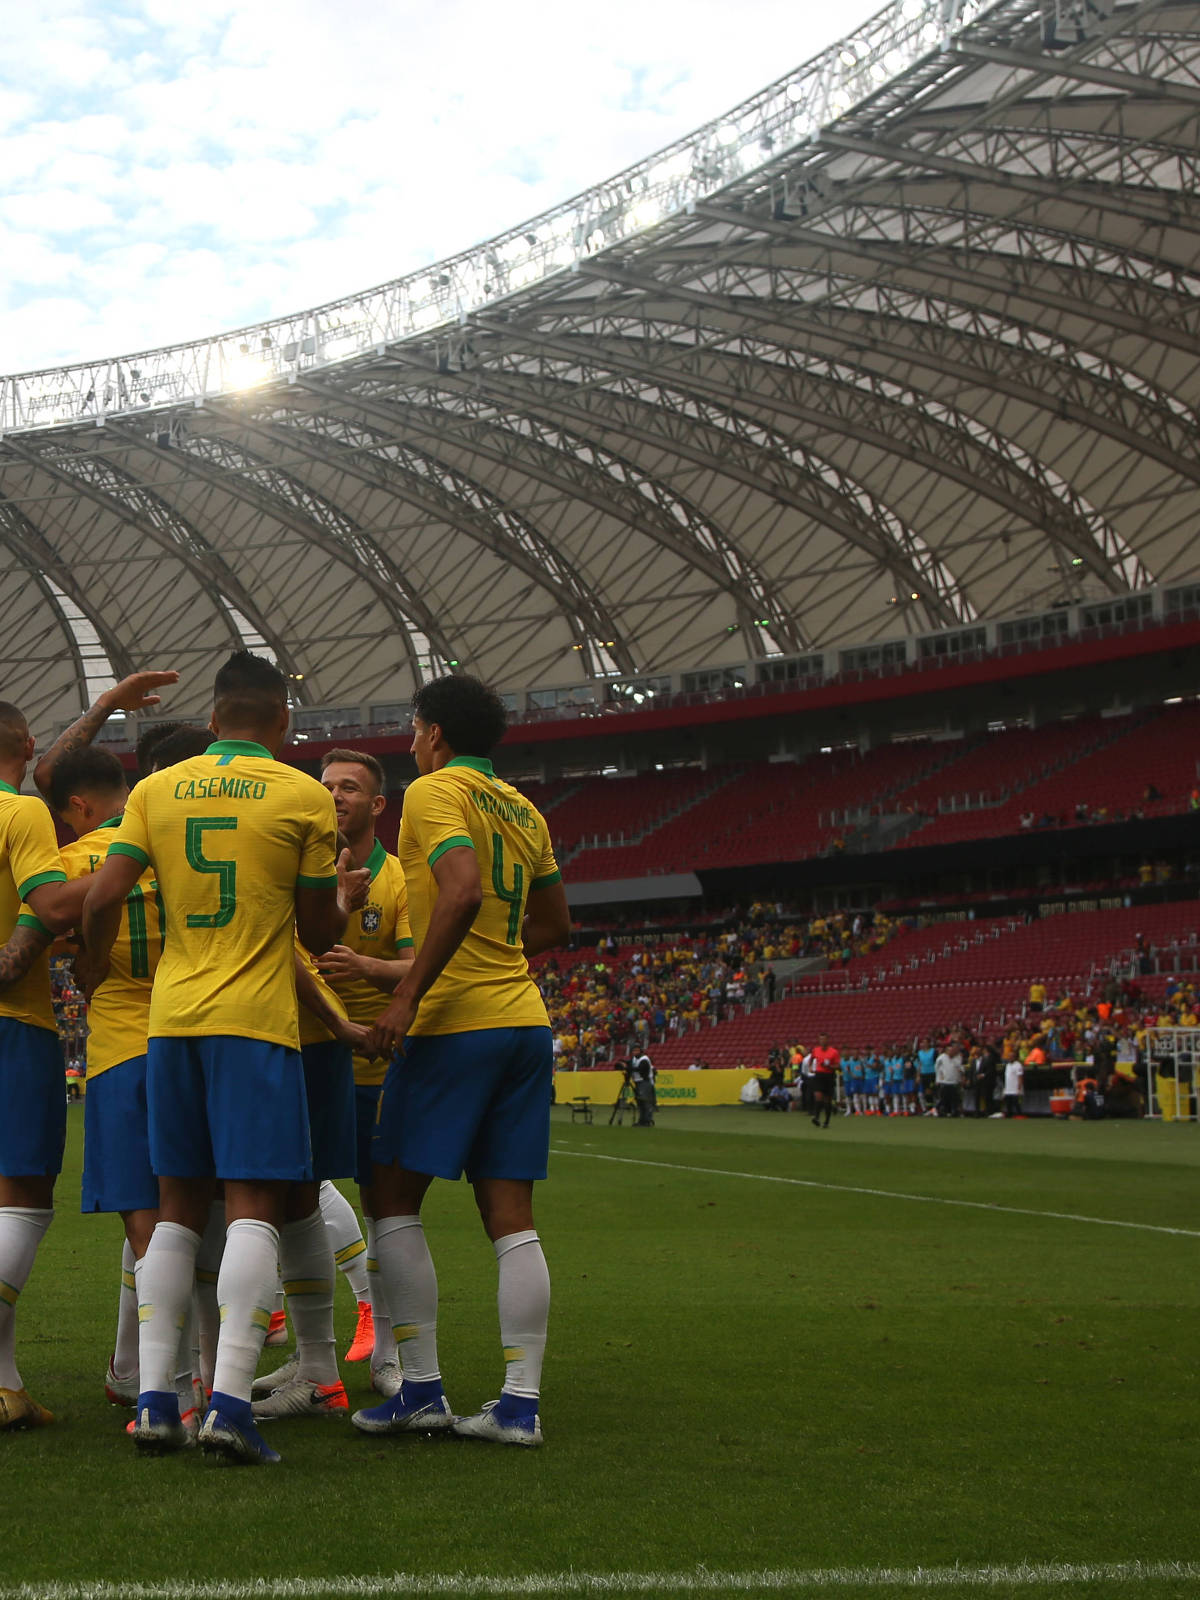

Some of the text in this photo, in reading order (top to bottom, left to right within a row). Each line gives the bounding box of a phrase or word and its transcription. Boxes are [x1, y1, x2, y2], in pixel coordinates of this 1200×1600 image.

[174, 777, 266, 800] CASEMIRO
[185, 816, 237, 928] 5
[492, 832, 523, 946] 4
